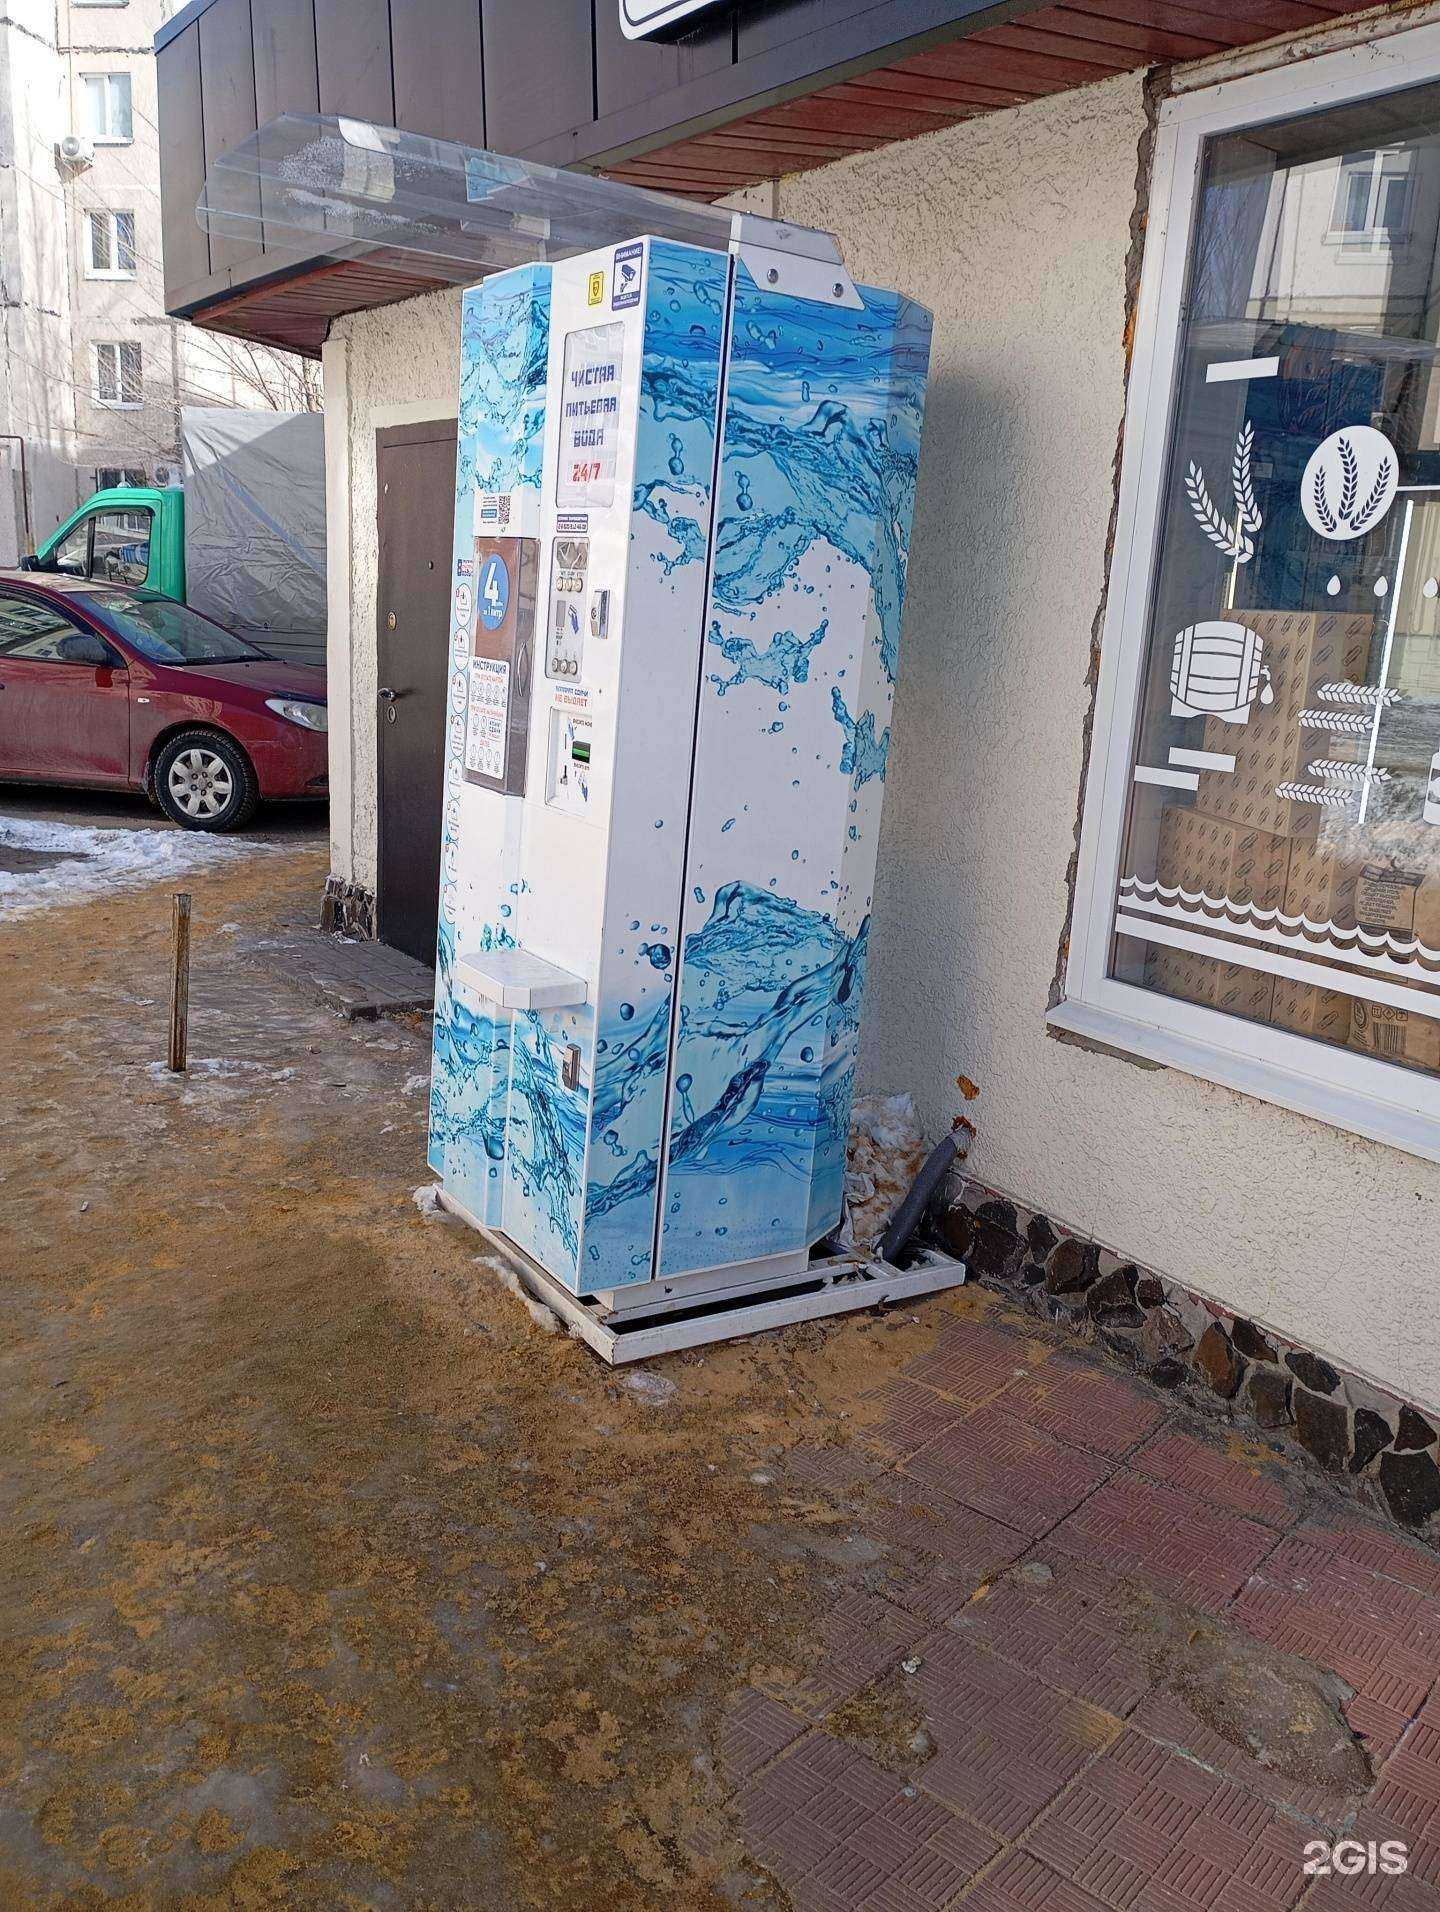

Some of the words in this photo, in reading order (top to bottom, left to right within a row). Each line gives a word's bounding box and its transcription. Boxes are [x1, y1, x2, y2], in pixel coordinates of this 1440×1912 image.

[571, 364, 615, 388] ЧИСТАЯ
[565, 396, 617, 418] ПИТЬЕВАЯ
[573, 428, 604, 448] ВОДА
[572, 462, 601, 482] 24/7
[484, 562, 499, 607] 4
[472, 659, 507, 676] ИНСТРУКЦИЯ
